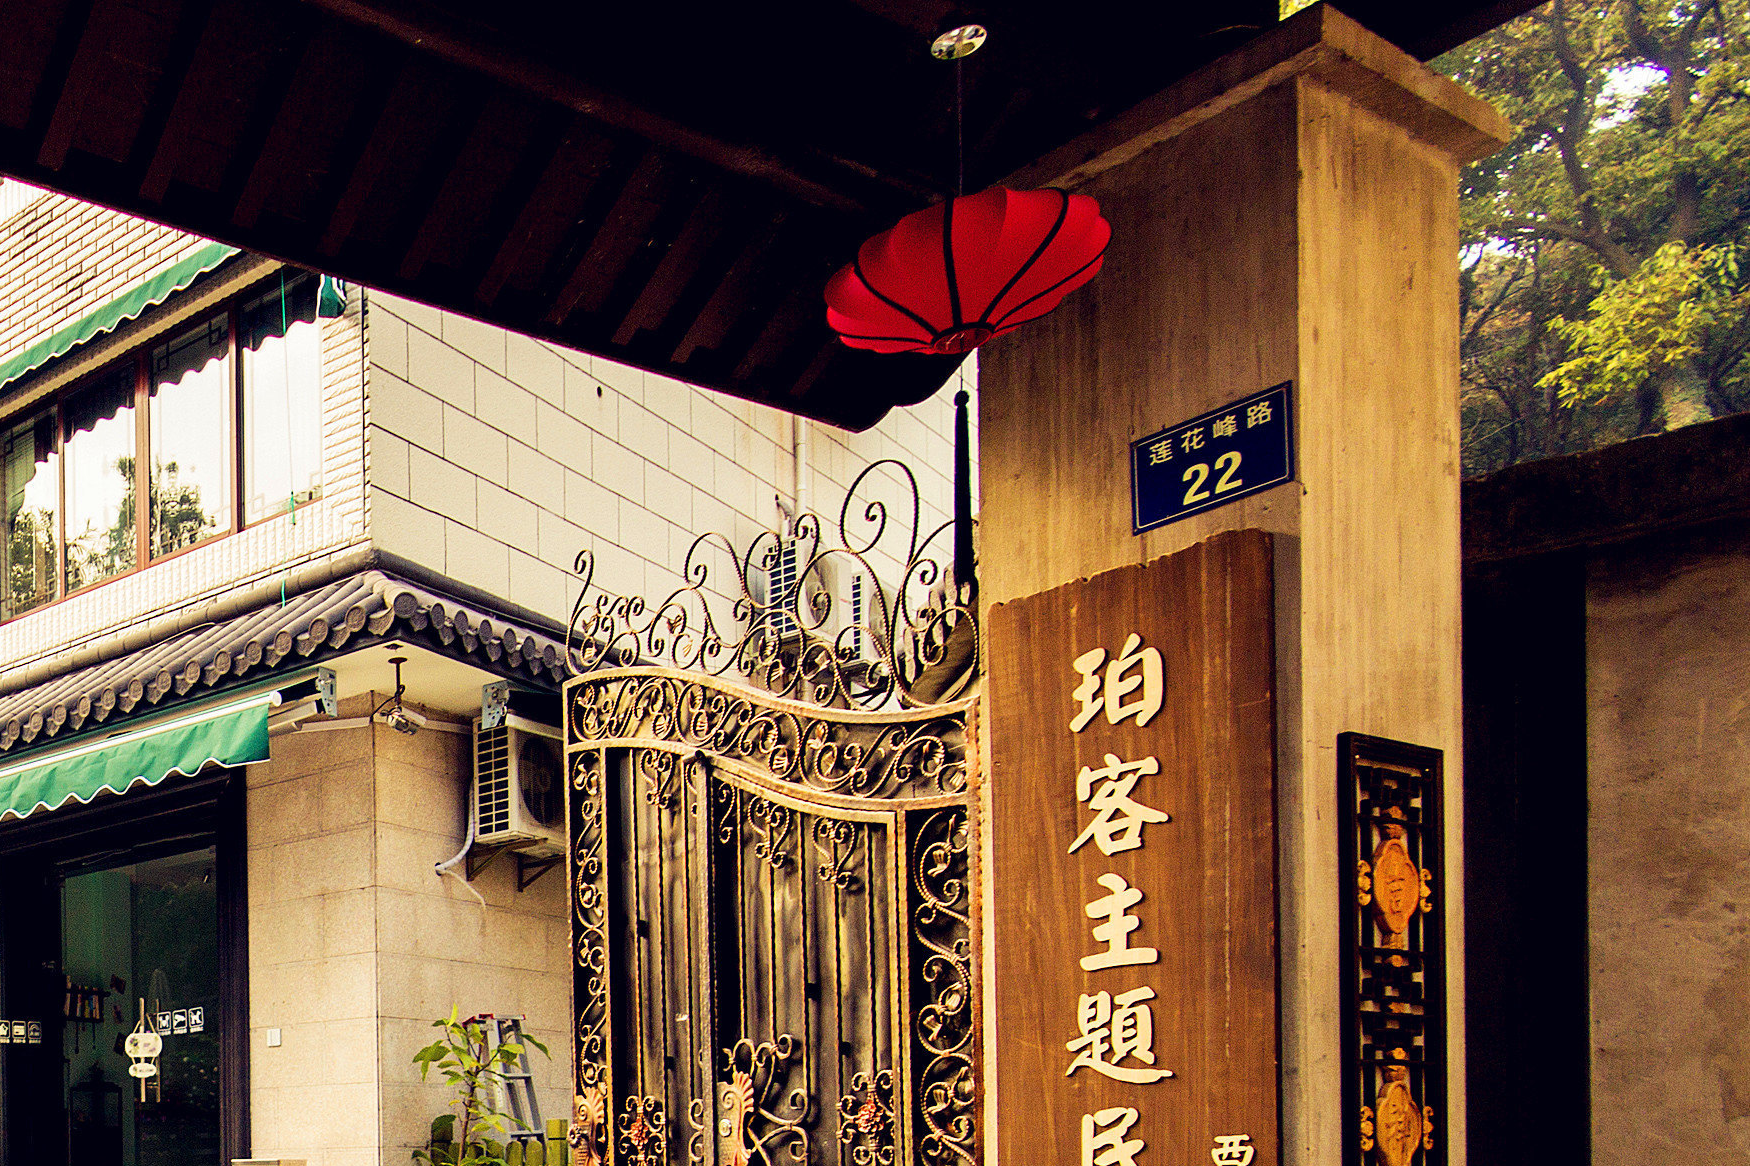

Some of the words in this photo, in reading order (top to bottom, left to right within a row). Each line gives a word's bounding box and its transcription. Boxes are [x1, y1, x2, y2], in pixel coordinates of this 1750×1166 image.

[1149, 401, 1273, 466] 莲花峰路
[1182, 451, 1243, 506] 22
